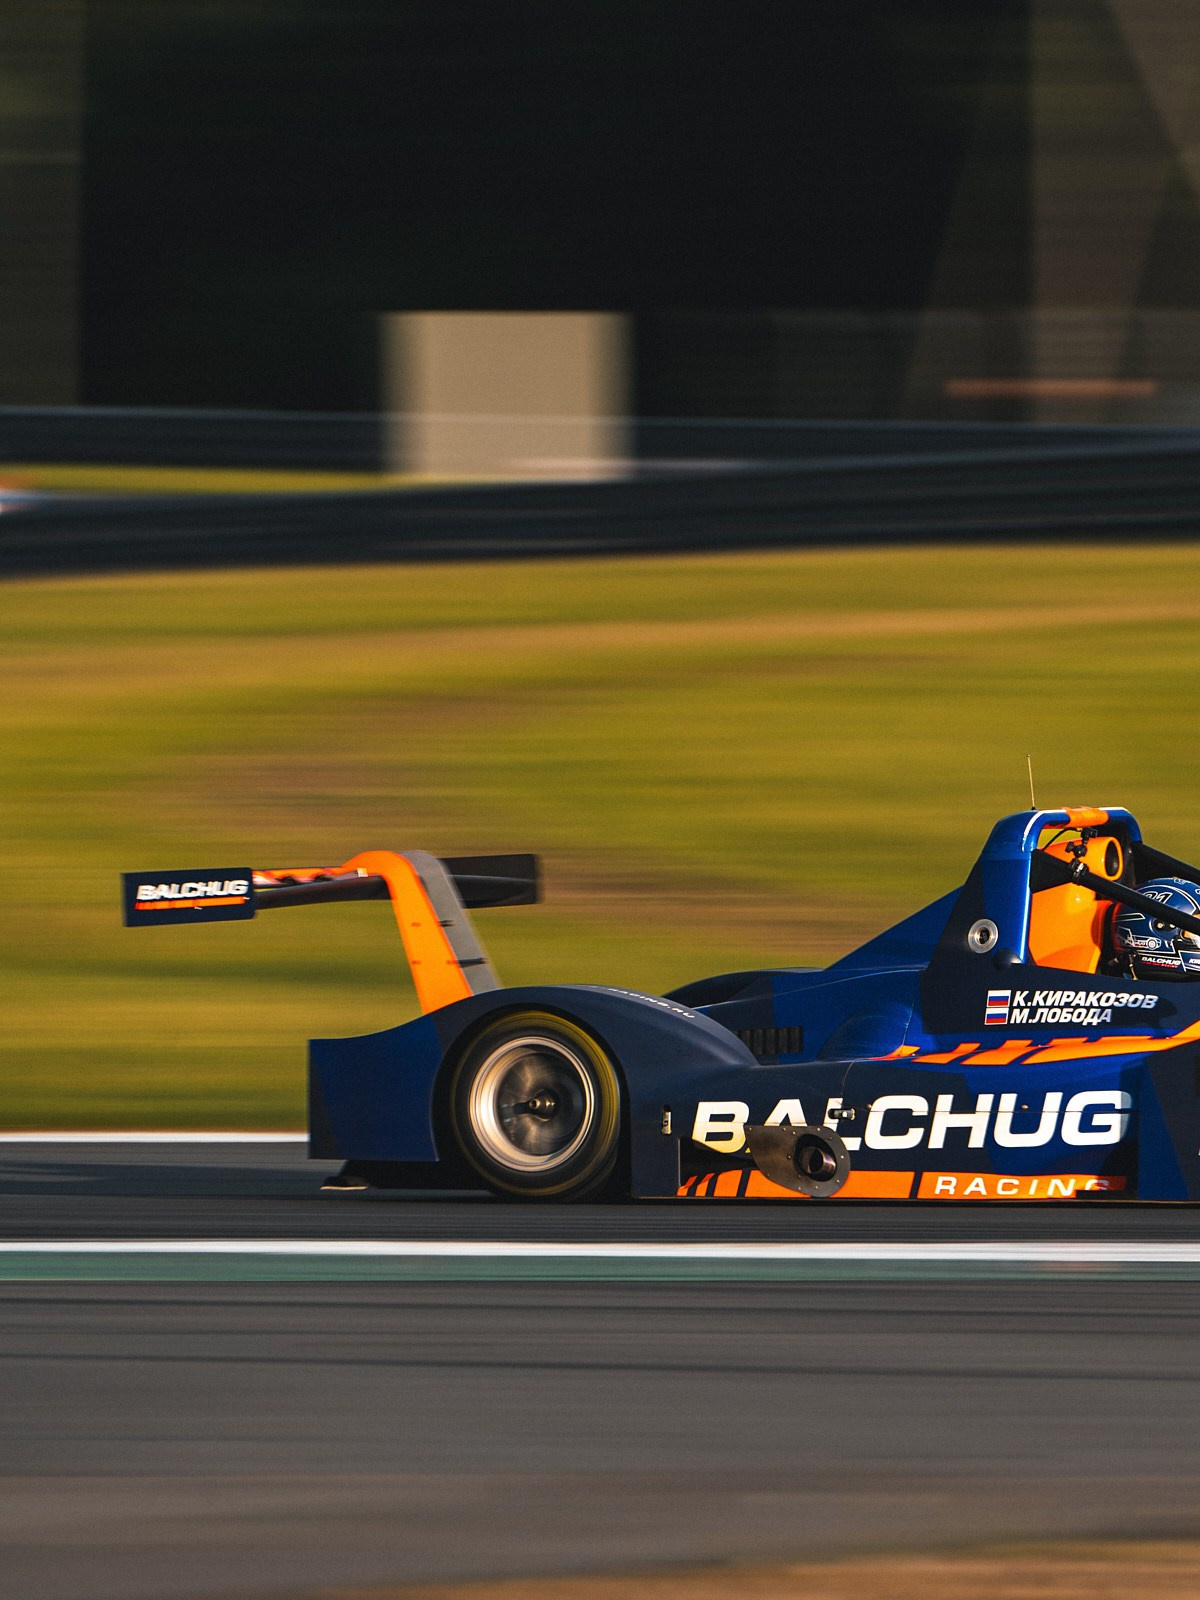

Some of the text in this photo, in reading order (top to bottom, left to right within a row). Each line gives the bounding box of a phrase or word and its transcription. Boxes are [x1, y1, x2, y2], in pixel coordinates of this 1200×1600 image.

[136, 879, 249, 901] BALCHUG
[1012, 990, 1158, 1009] К.КИРАКОЗОВ
[1010, 1007, 1112, 1026] М.ЛОБОДА
